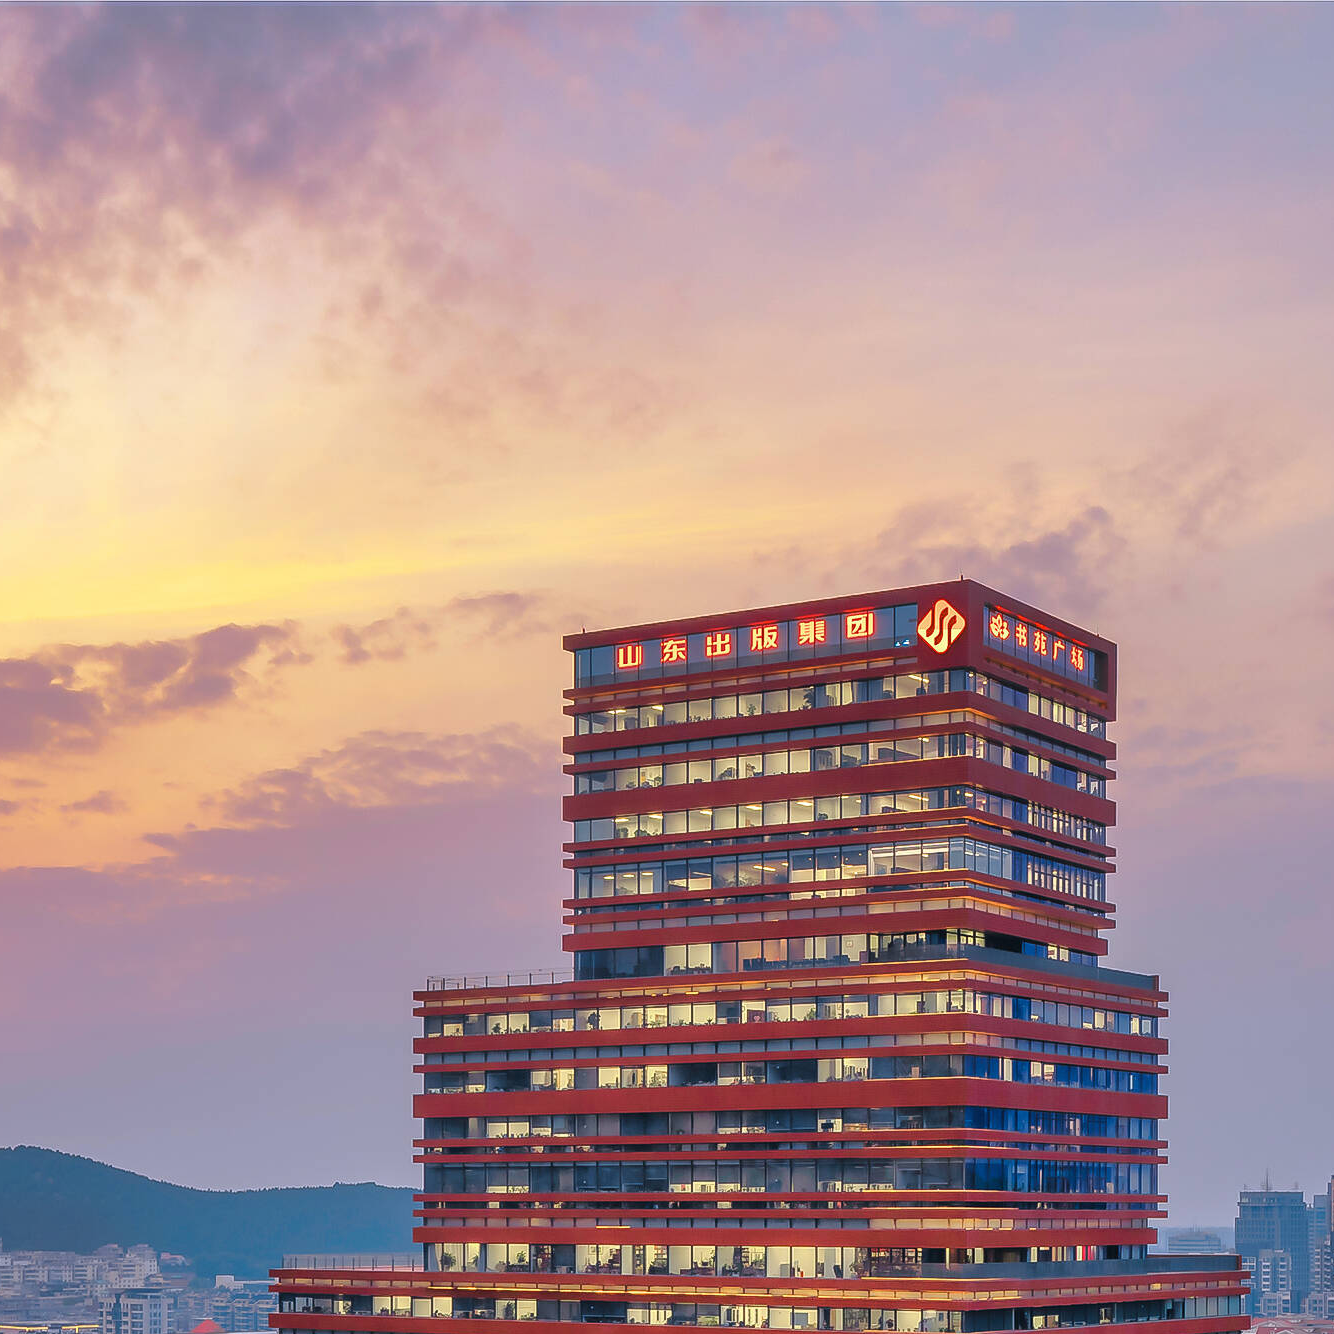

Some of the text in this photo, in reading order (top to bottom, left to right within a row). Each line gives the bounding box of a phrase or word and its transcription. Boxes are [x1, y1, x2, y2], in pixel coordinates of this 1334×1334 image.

[617, 612, 875, 668] 山东出版集团
[1015, 622, 1085, 671] 书苑广场
